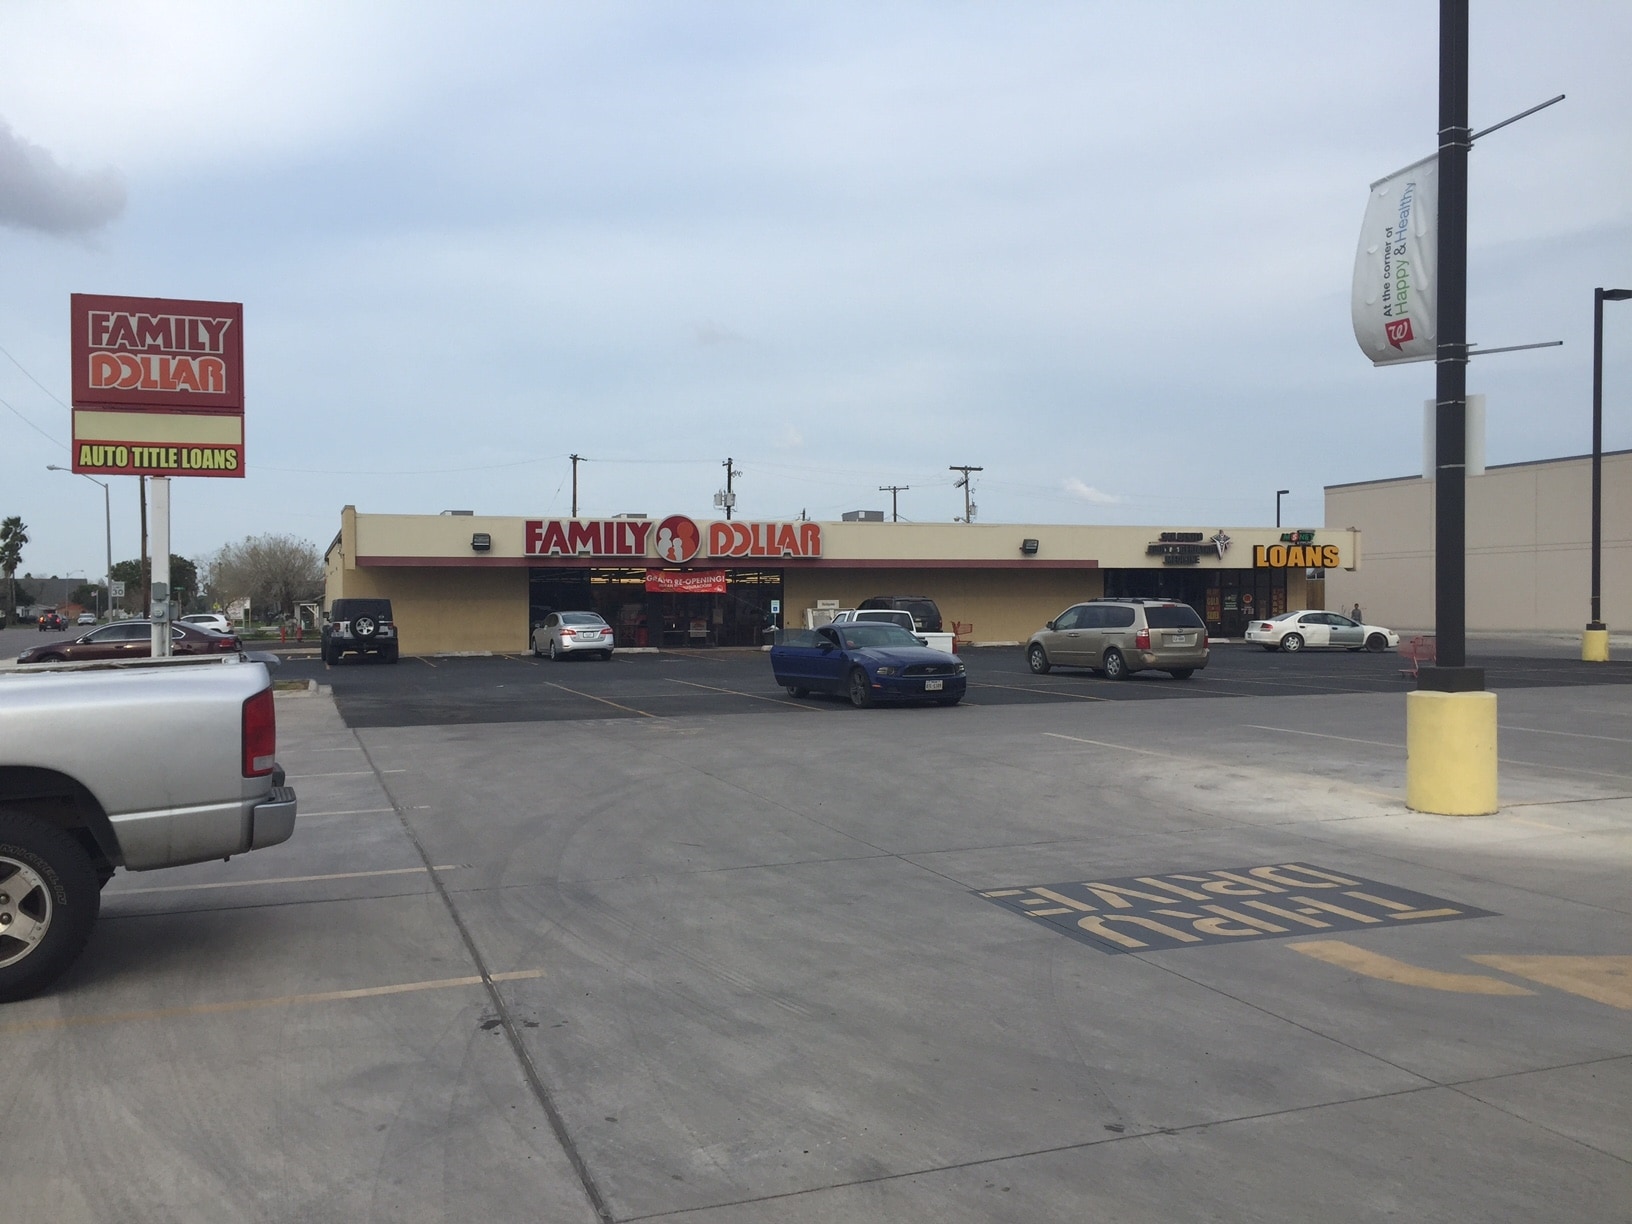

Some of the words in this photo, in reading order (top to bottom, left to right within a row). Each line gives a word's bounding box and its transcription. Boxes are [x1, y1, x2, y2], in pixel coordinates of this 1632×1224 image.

[1396, 183, 1416, 243] Healthy
[1386, 227, 1393, 239] of
[1394, 243, 1407, 256] &
[1383, 242, 1393, 283] corner
[1382, 284, 1391, 303] the
[1395, 259, 1410, 316] Happy
[1382, 304, 1393, 317] At
[88, 310, 233, 354] FAMILY
[88, 351, 226, 394] DOLLAR
[78, 444, 128, 468] AUTO
[131, 445, 178, 469] TITLE
[181, 447, 238, 471] LOANS
[524, 520, 654, 556] FAMILY
[707, 521, 822, 557] DOLLAR
[1253, 544, 1340, 569] LOANS
[111, 586, 123, 596] 30
[979, 862, 1362, 917] DRIVE
[1077, 890, 1463, 949] THRU
